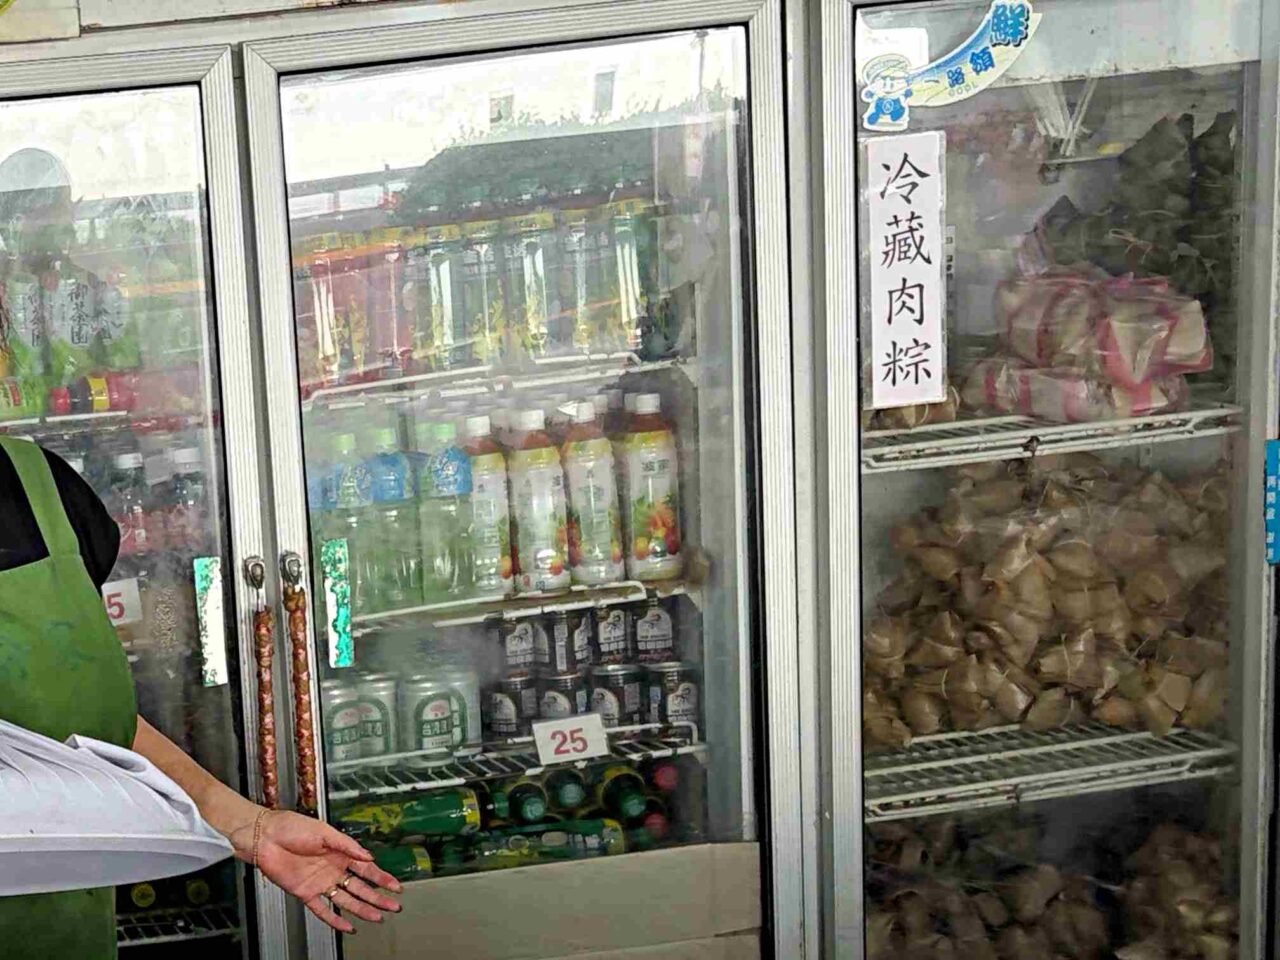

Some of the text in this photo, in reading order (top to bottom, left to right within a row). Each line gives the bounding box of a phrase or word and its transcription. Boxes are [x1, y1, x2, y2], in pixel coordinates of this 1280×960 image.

[880, 152, 932, 388] 冷藏肉粽
[550, 728, 588, 756] 25
